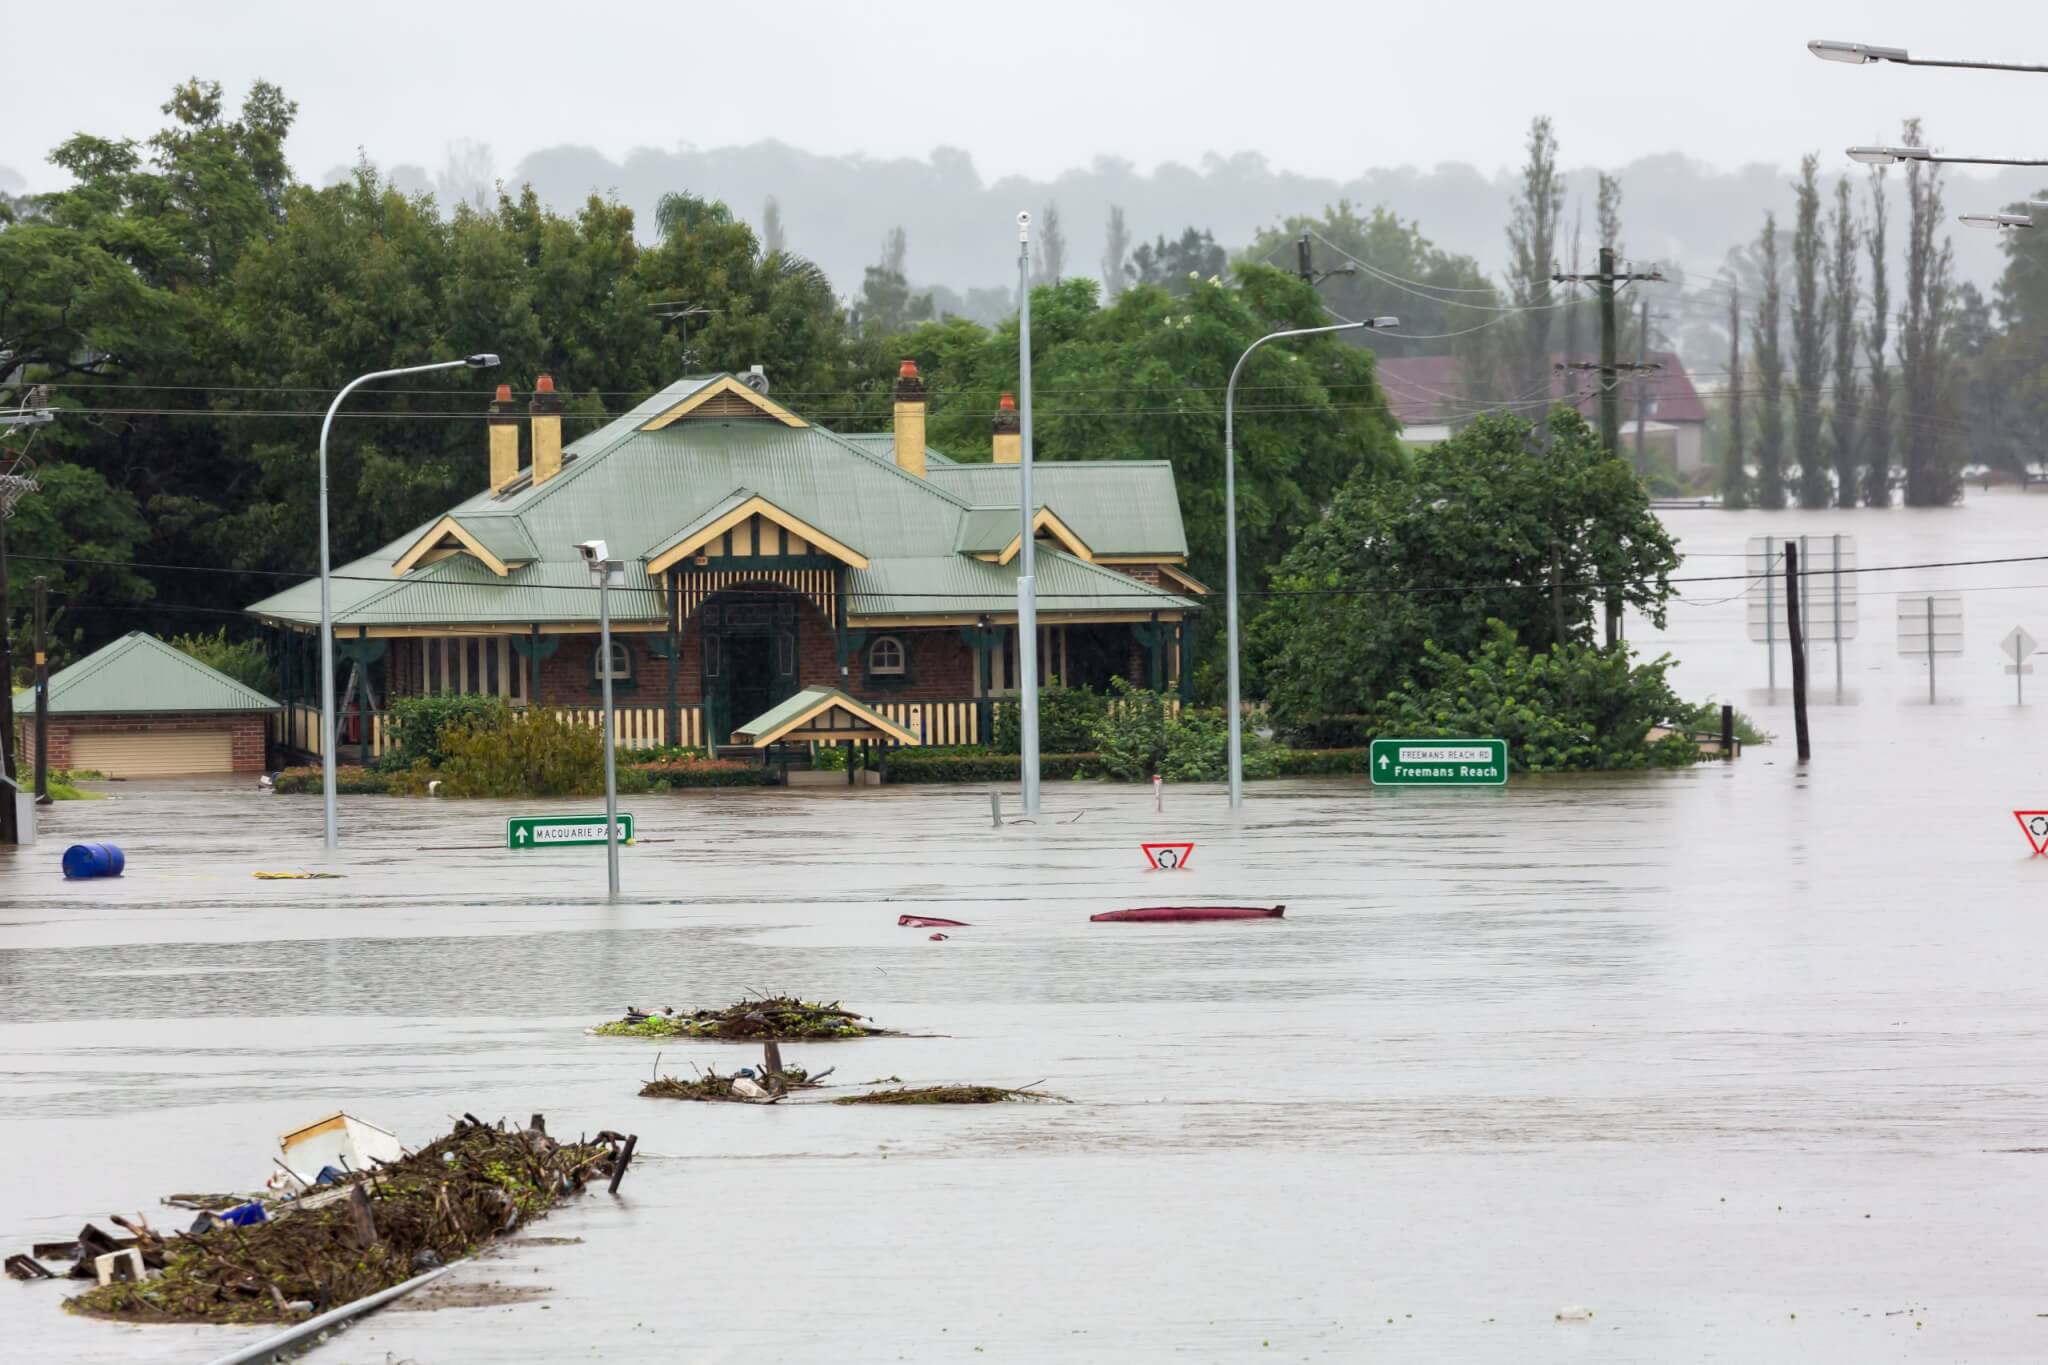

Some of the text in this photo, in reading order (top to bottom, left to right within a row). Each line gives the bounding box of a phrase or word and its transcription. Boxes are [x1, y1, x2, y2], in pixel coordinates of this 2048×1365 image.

[1402, 751, 1489, 759] FREEMANS REACH RD
[1394, 766, 1498, 777] Freemans Reach
[536, 827, 623, 839] MACQUARIE PAK
